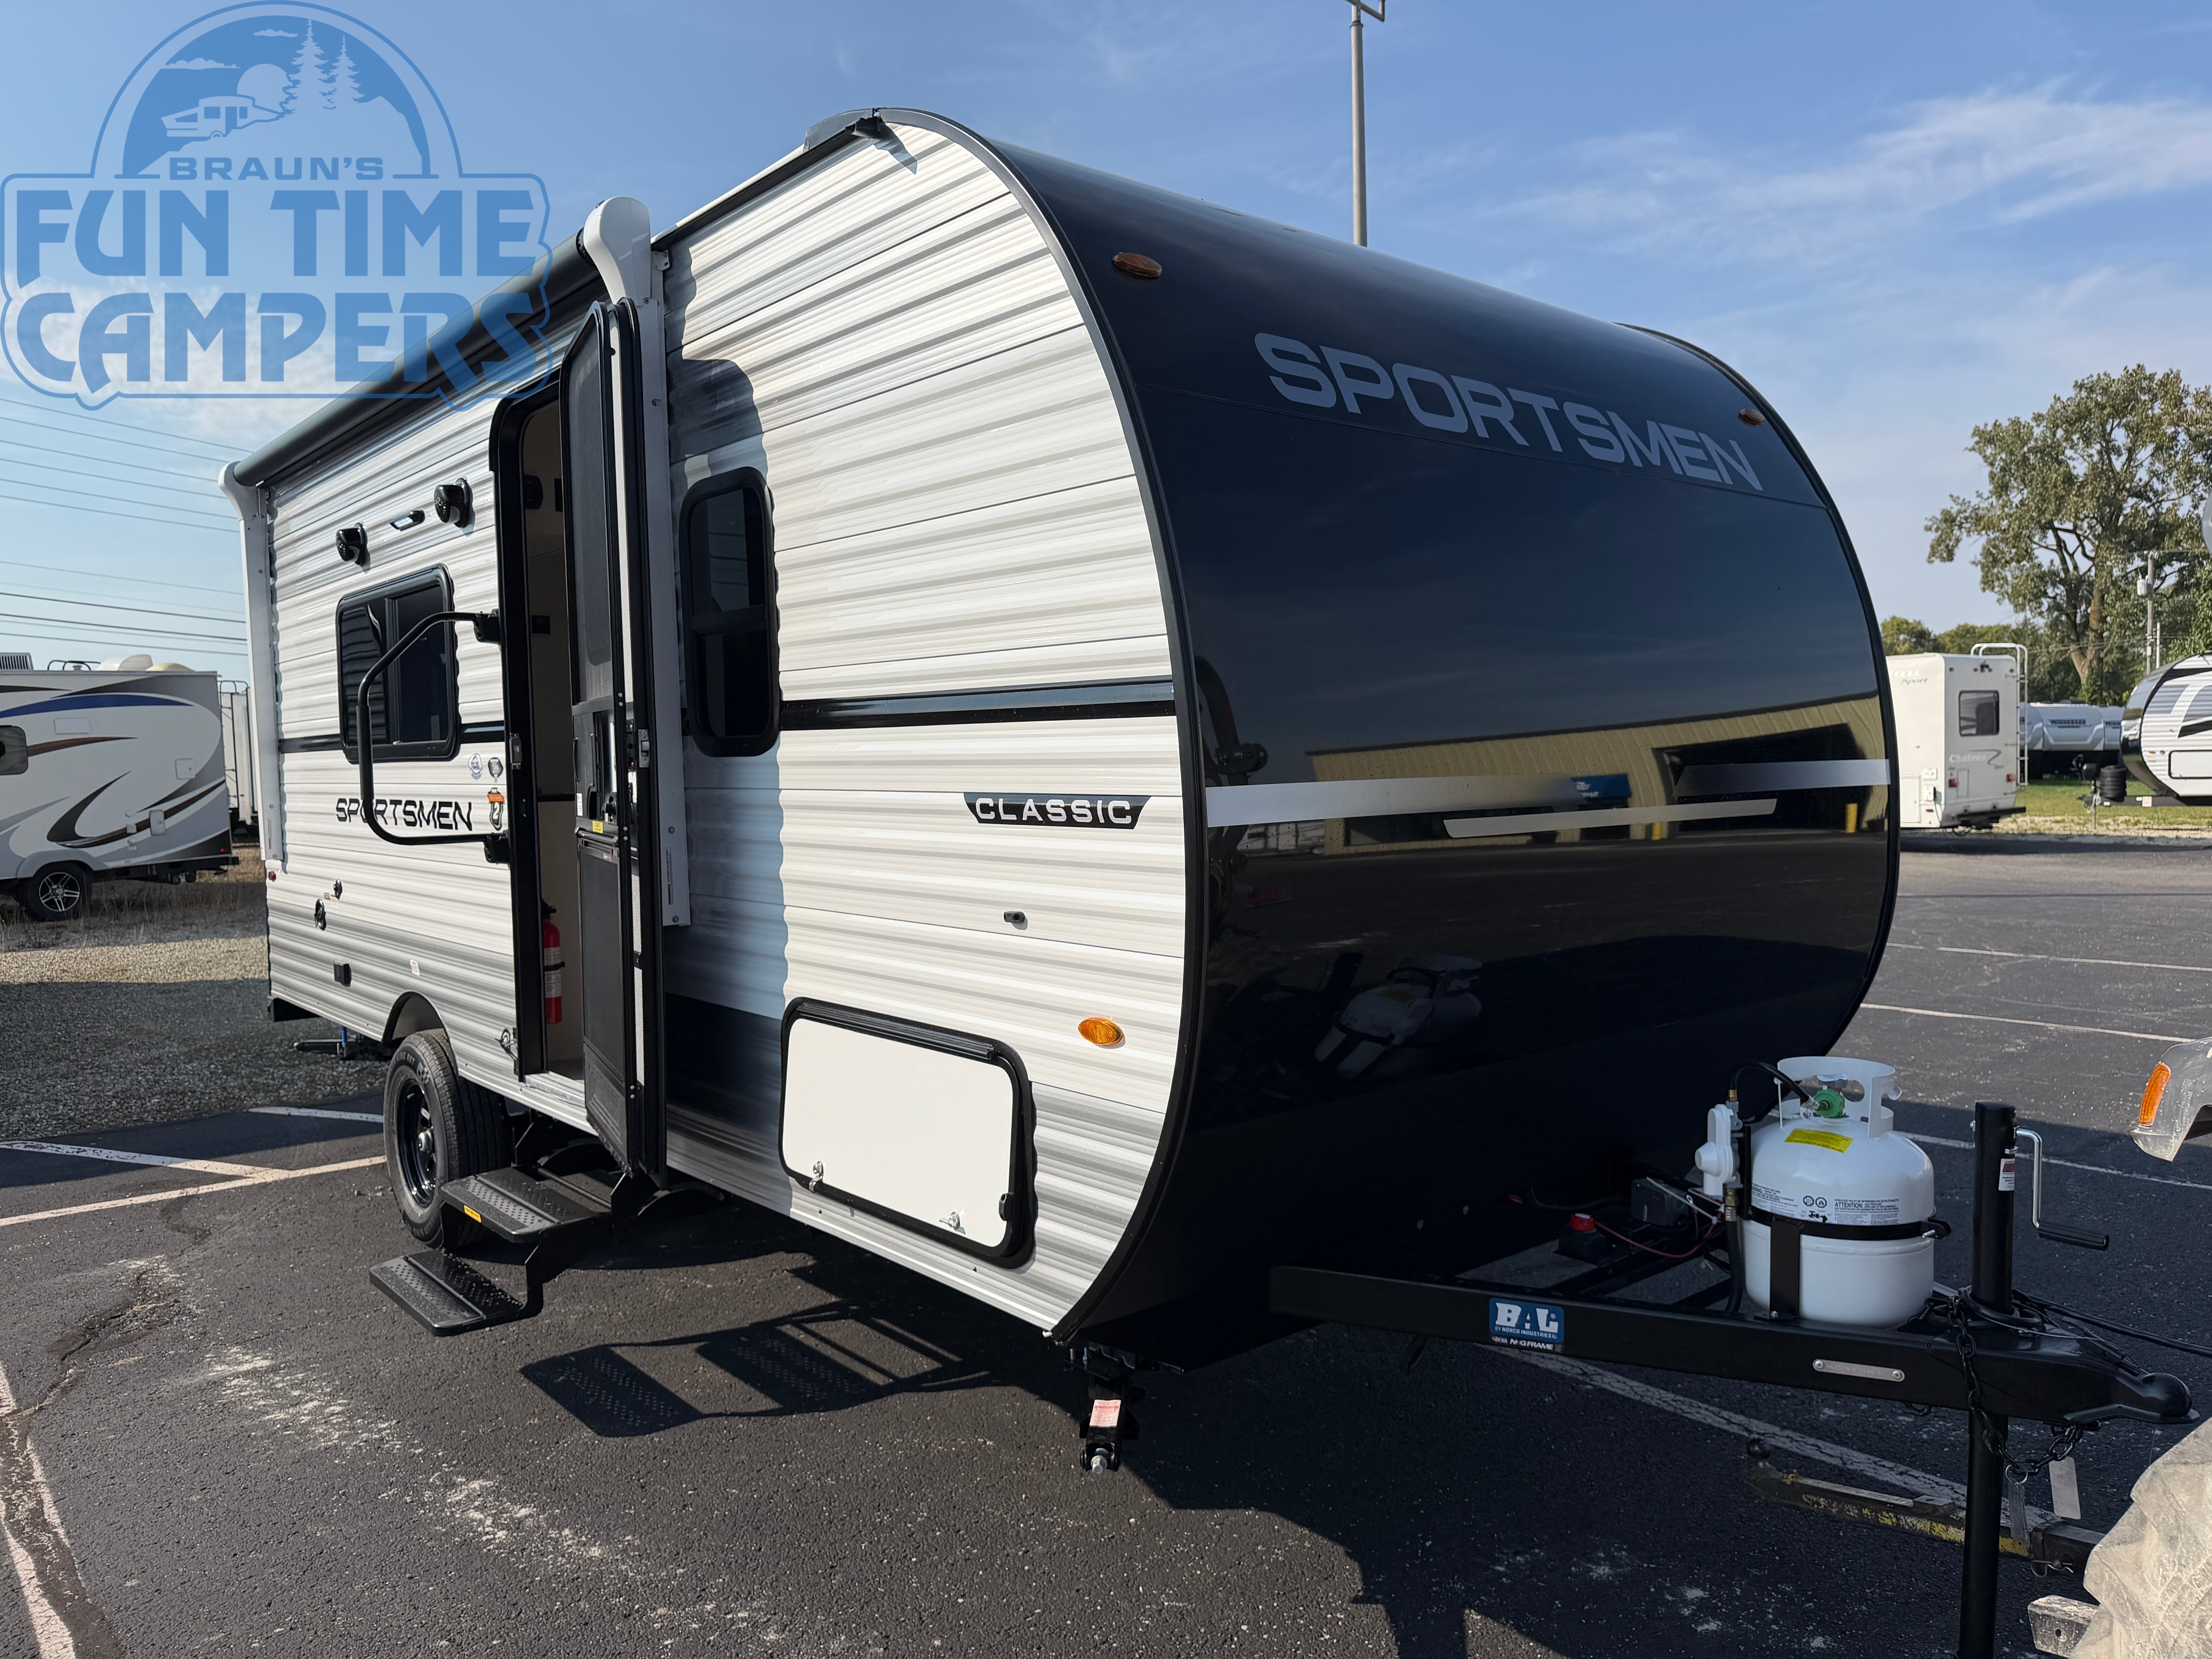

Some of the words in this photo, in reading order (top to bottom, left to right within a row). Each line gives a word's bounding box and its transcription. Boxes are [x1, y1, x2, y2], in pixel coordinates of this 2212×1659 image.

[1254, 332, 1764, 491] SPORTSMEN
[975, 797, 1132, 824] CLASSIC
[1495, 1302, 1559, 1333] BAL
